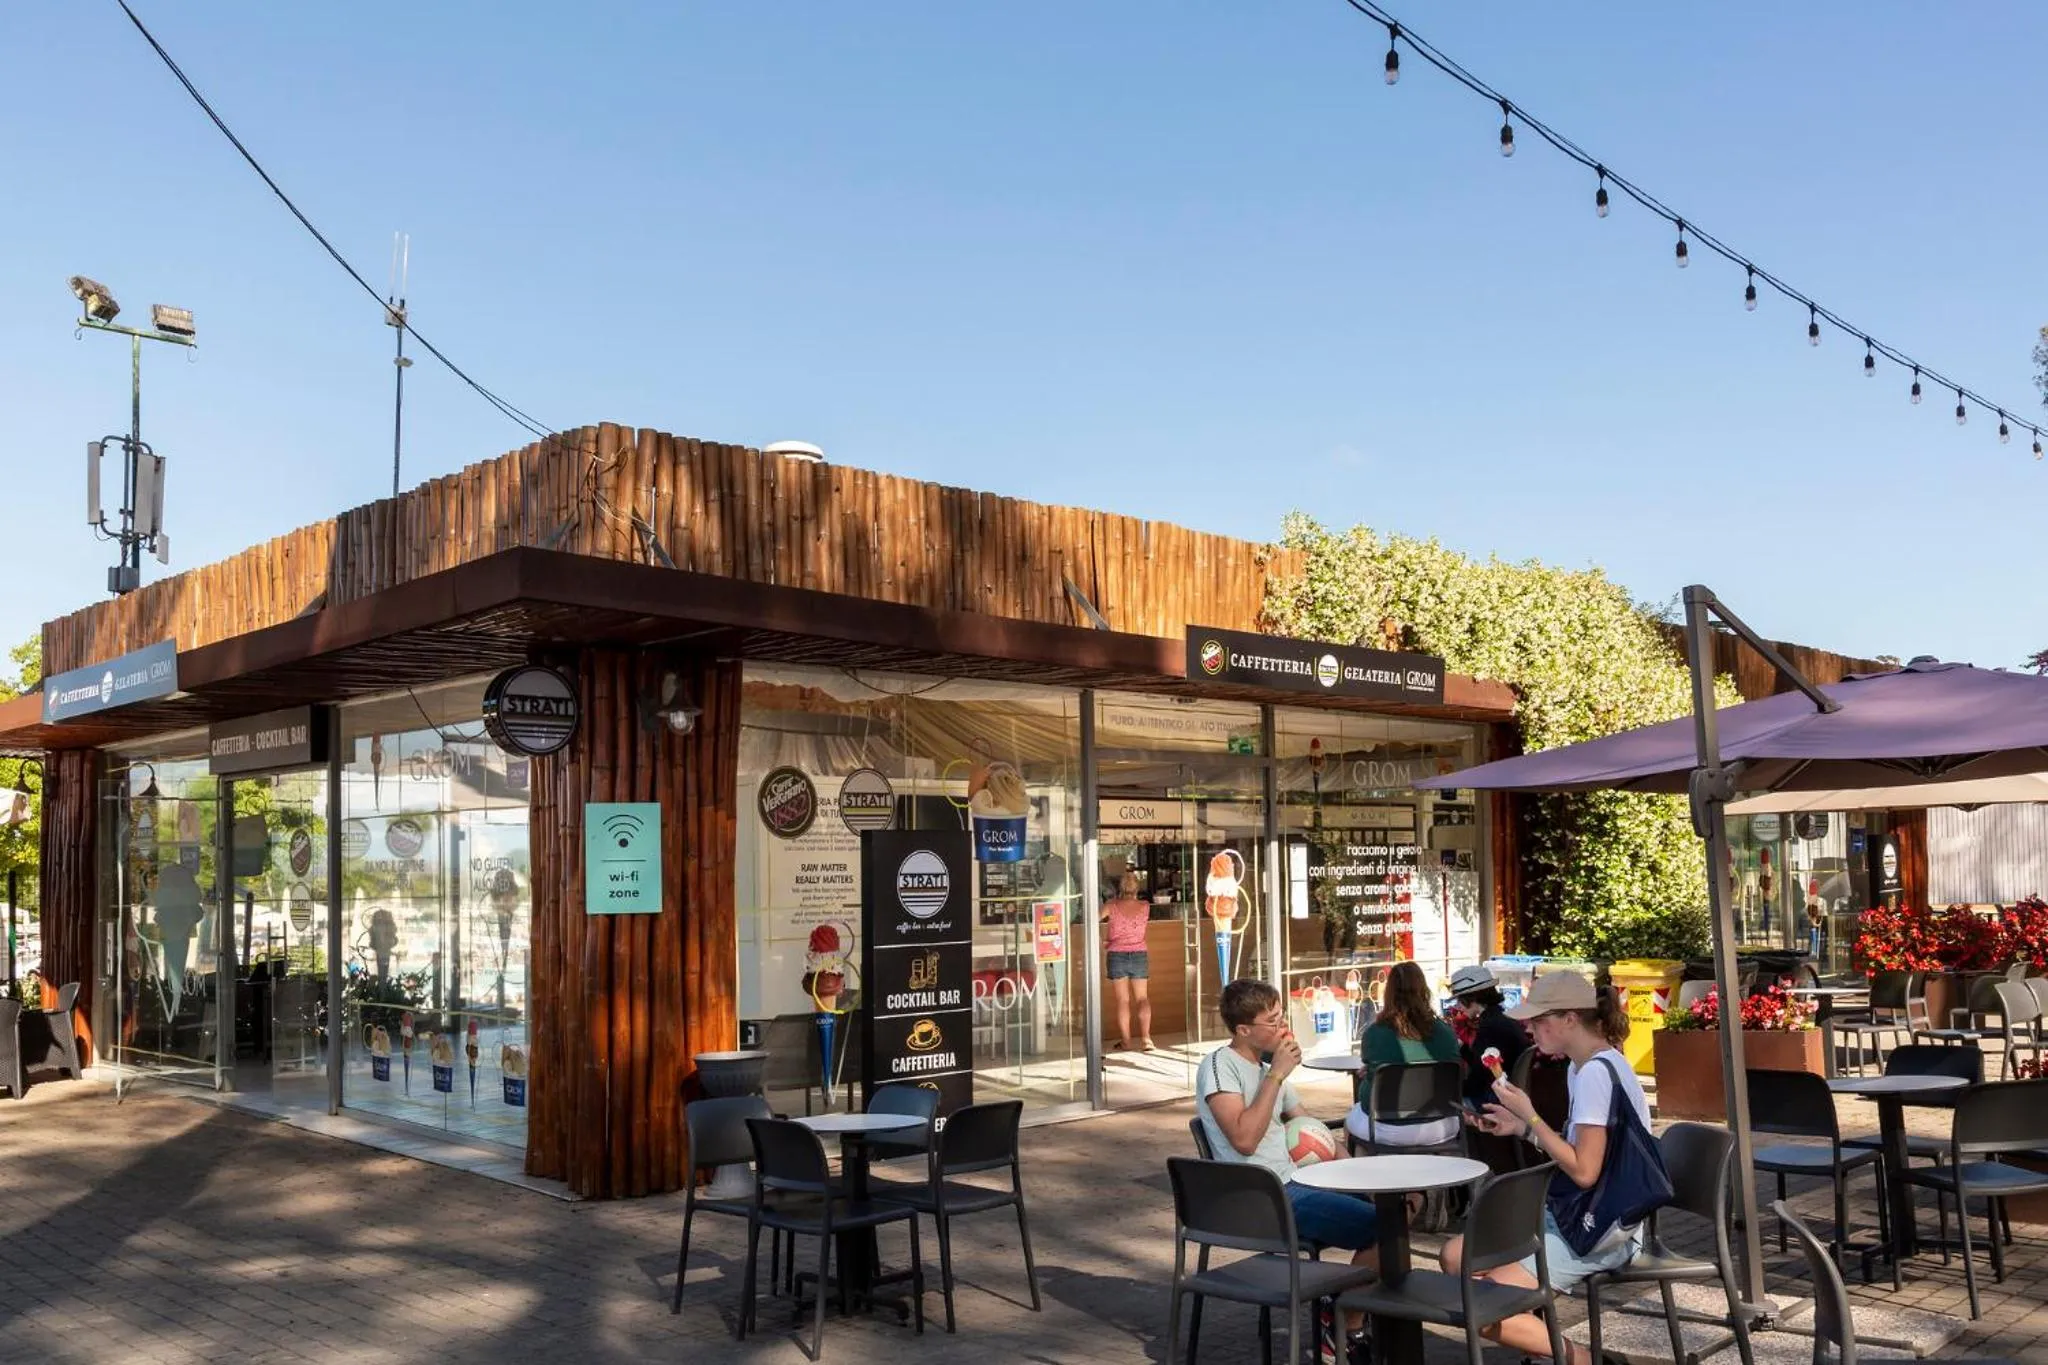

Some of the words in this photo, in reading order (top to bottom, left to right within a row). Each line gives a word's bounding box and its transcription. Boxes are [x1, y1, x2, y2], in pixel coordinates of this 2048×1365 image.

[1230, 653, 1313, 676] CAFFETTERIA
[1344, 666, 1401, 685] GELATERIA
[1406, 671, 1437, 687] GROM
[60, 684, 100, 704] CAFFETTERIA
[507, 698, 569, 715] STRATI
[212, 735, 251, 757] CAFFETTERIA
[256, 728, 290, 751] COCKTAIL
[291, 725, 307, 745] BAR
[1352, 760, 1412, 787] GROM
[844, 793, 891, 808] STRATI
[1119, 806, 1155, 820] GROM
[982, 829, 1018, 843] GROM
[801, 863, 818, 872] RAW
[820, 863, 848, 872] MATTER
[1309, 865, 1326, 877] con
[1327, 860, 1375, 880] ingredienti
[1376, 860, 1386, 875] di
[1387, 863, 1417, 878] origine
[609, 870, 639, 883] wi-fi
[795, 876, 821, 884] REALLY
[822, 875, 854, 884] MATTERS
[903, 875, 947, 888] STRATI
[609, 887, 640, 898] zone
[1336, 885, 1362, 896] senza
[1353, 904, 1360, 915] o
[1356, 920, 1383, 936] Senza
[887, 991, 937, 1009] COCKTAIL
[940, 989, 961, 1005] BAR
[972, 975, 1041, 1012] ROM
[892, 1052, 957, 1073] CAFFETTERIA
